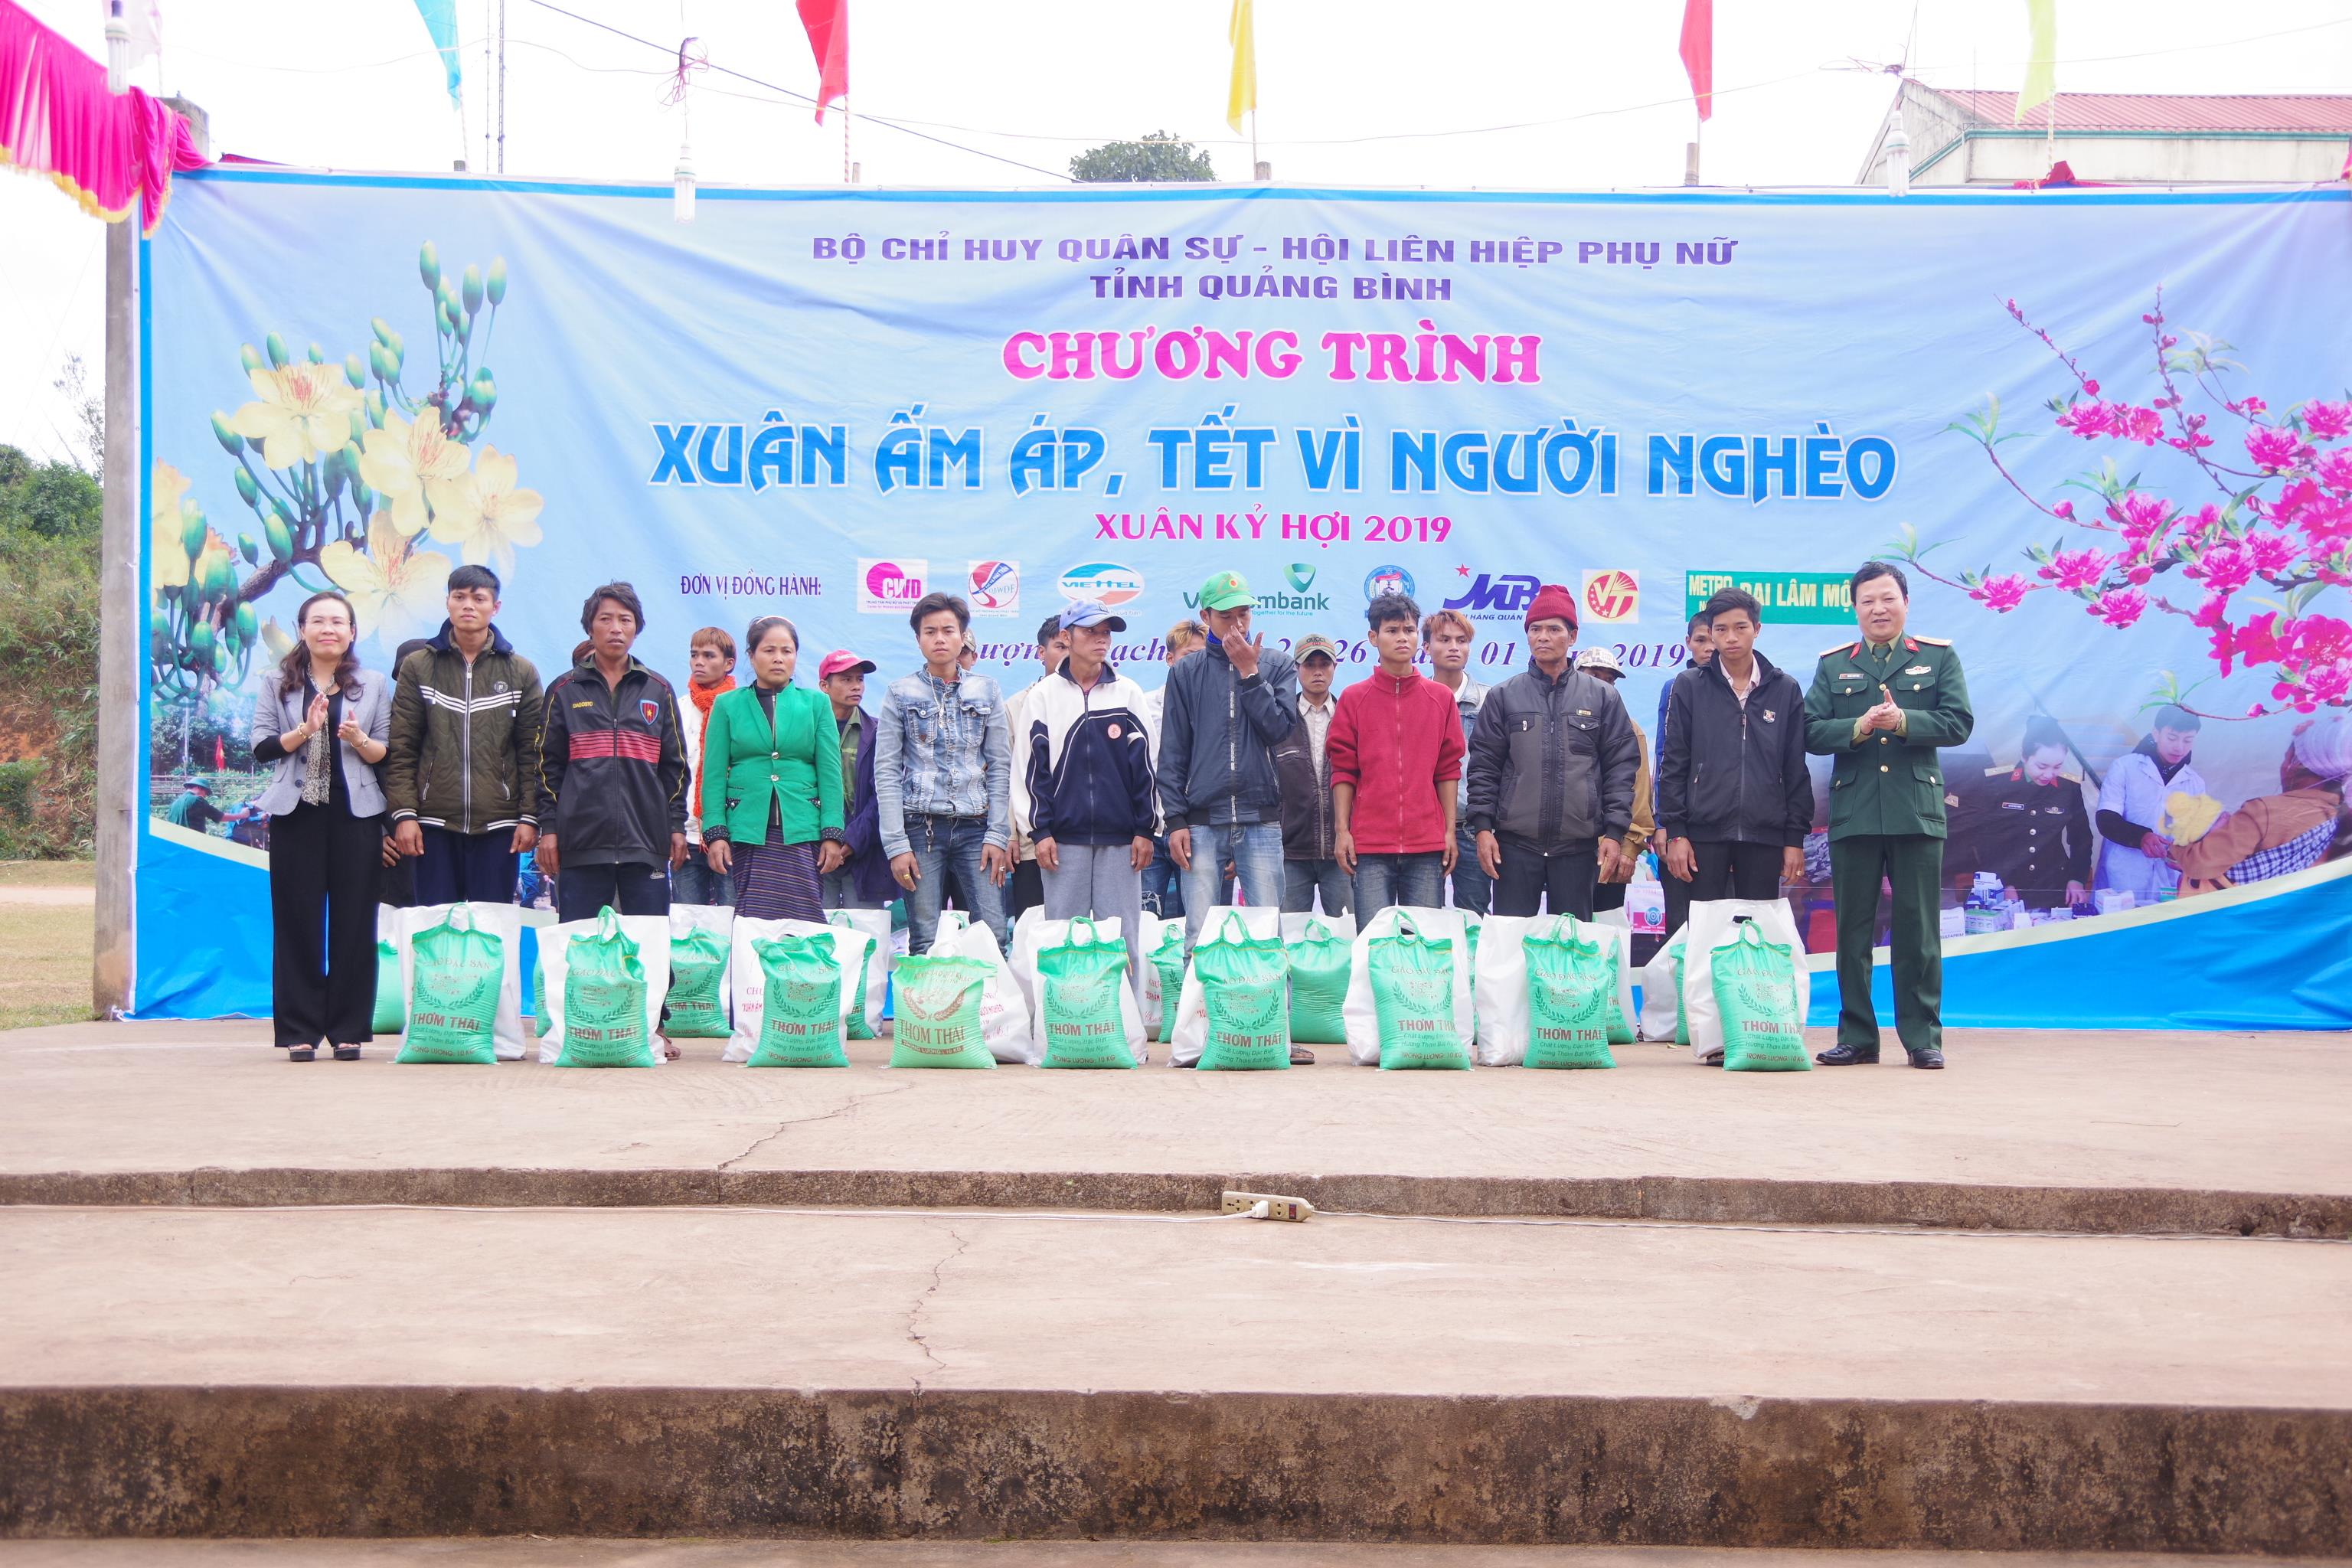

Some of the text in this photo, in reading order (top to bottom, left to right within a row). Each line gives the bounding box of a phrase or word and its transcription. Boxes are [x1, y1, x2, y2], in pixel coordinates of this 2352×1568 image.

[812, 233, 866, 264] BỘ
[881, 230, 950, 261] CHỈ
[963, 238, 1043, 261] HUY
[1057, 233, 1170, 262] QUÂN
[1184, 234, 1243, 264] SỰ
[1282, 234, 1350, 266] HỘI
[1365, 234, 1455, 263] LIÊN
[1470, 236, 1563, 272] HIỆP
[1578, 240, 1661, 272] PHỤ
[1675, 236, 1739, 266] NỮ
[1090, 265, 1452, 302] TỈNH QUẢNG BÌNH
[1003, 318, 1542, 384] CHƯƠNG TRÌNH
[648, 402, 1899, 508] XUÂN ẤM ÁP, TẾT VÌ NGƯỜI NGHÈO
[1094, 503, 1452, 550] XUÂN KỶ HỢI 2019
[681, 568, 822, 600] ĐƠN VỊ ĐỒNG HÀNH:
[883, 577, 922, 599] CWD
[1061, 580, 1140, 589] VIETTEL
[1443, 574, 1541, 611] MB
[1593, 573, 1639, 619] VT
[1776, 579, 1817, 607] LÂM
[1470, 612, 1495, 621] HÀNG
[1480, 641, 1517, 665] 01
[1612, 643, 1686, 668] 2019
[413, 1012, 481, 1031] THƠM THÁI
[568, 1026, 603, 1041] THƠM
[771, 1019, 806, 1036] THƠM
[811, 1020, 835, 1036] THÁI
[900, 1019, 932, 1044] THƠM
[934, 1025, 966, 1045] THÁI
[1050, 1019, 1116, 1037] THƠM THÁI
[1397, 1018, 1435, 1032] THƠM
[1536, 1025, 1602, 1041] THƠM THÁI
[1742, 1020, 1779, 1034] THƠM
[1217, 1030, 1282, 1048] THƠM THÁI
